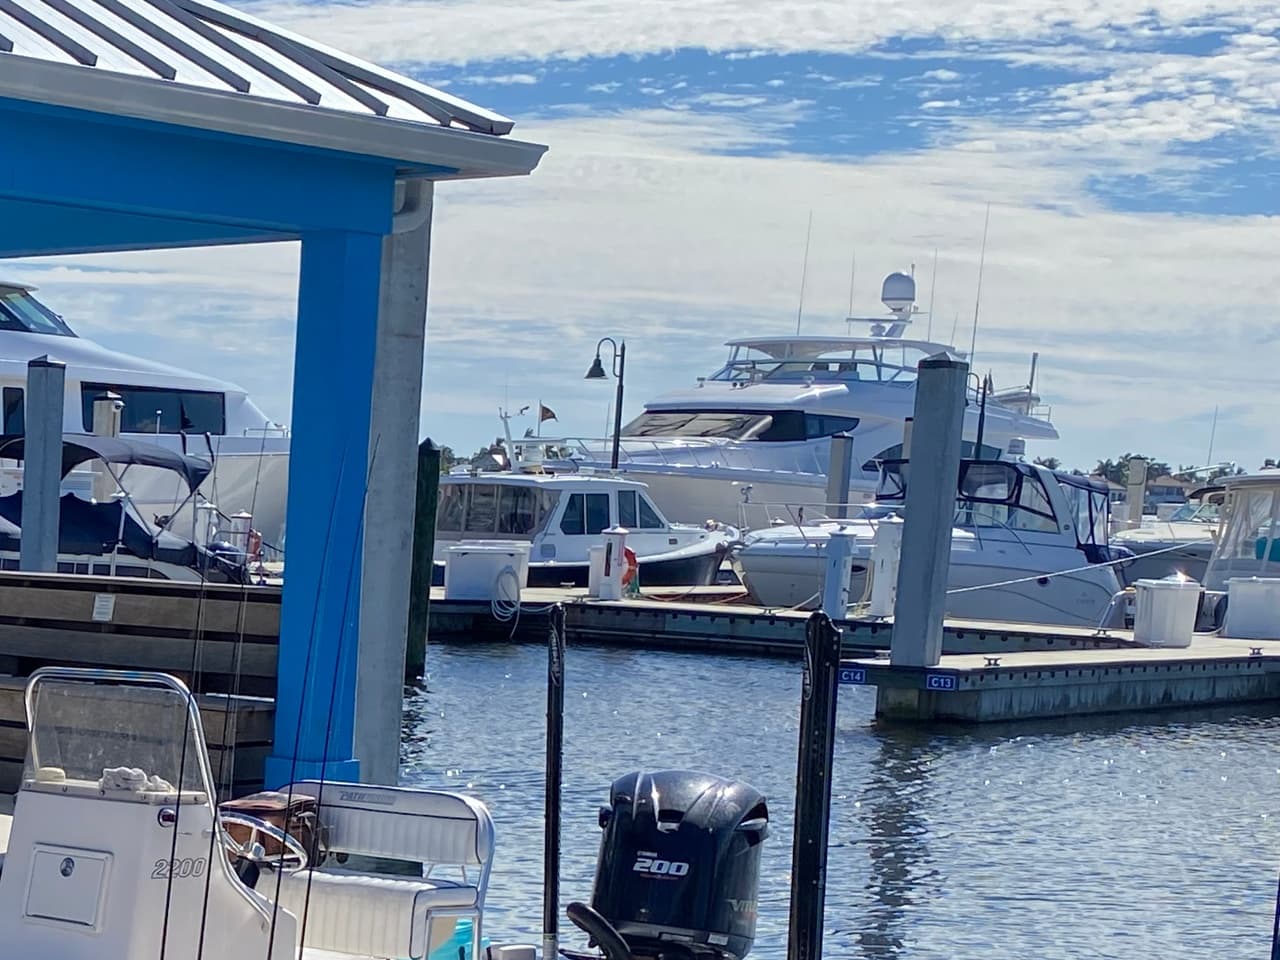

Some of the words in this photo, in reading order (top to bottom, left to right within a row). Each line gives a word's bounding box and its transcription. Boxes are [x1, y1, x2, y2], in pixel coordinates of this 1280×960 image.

[841, 671, 862, 681] C14
[931, 677, 952, 688] C13
[151, 857, 207, 880] 2200
[633, 858, 689, 876] 200
